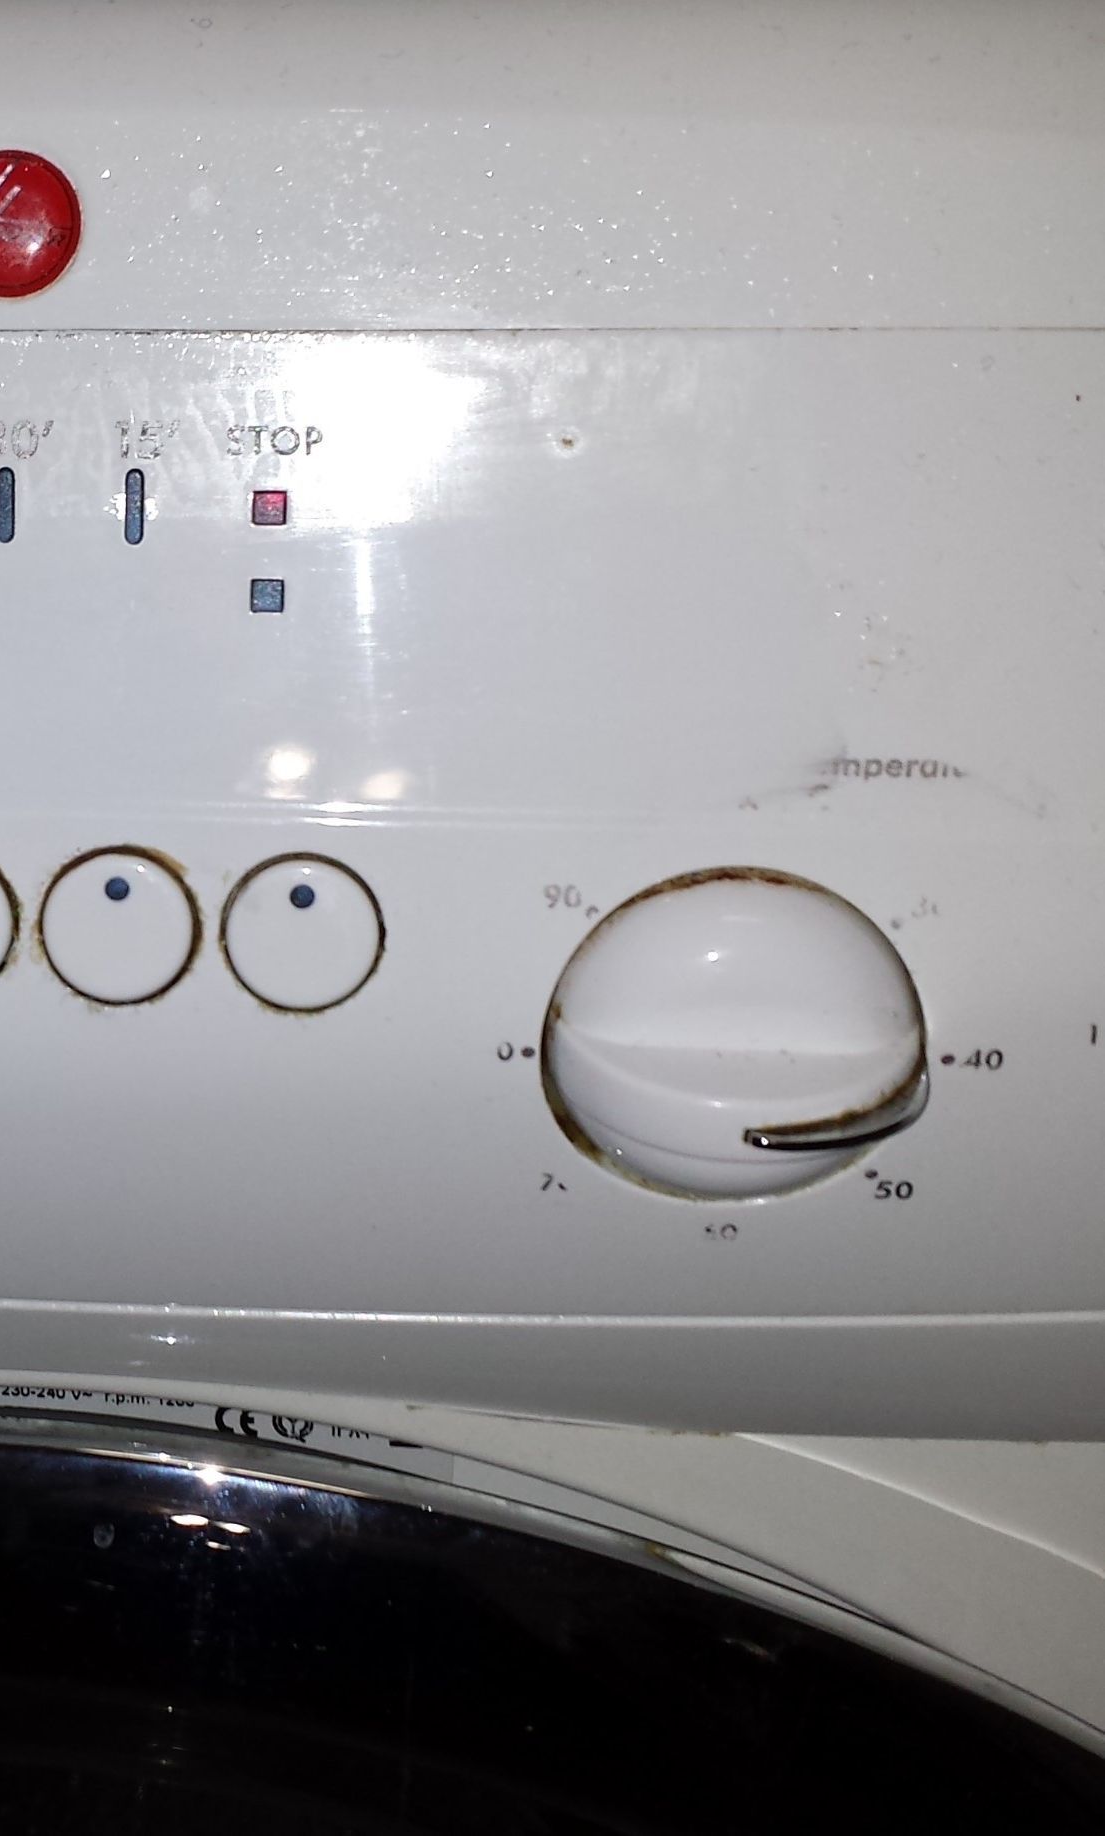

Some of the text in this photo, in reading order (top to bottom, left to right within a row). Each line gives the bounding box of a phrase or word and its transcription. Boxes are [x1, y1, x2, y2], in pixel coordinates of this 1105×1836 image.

[226, 425, 323, 456] STOP
[544, 884, 582, 909] 90
[962, 1049, 1004, 1070] 40
[875, 1180, 914, 1200] 50
